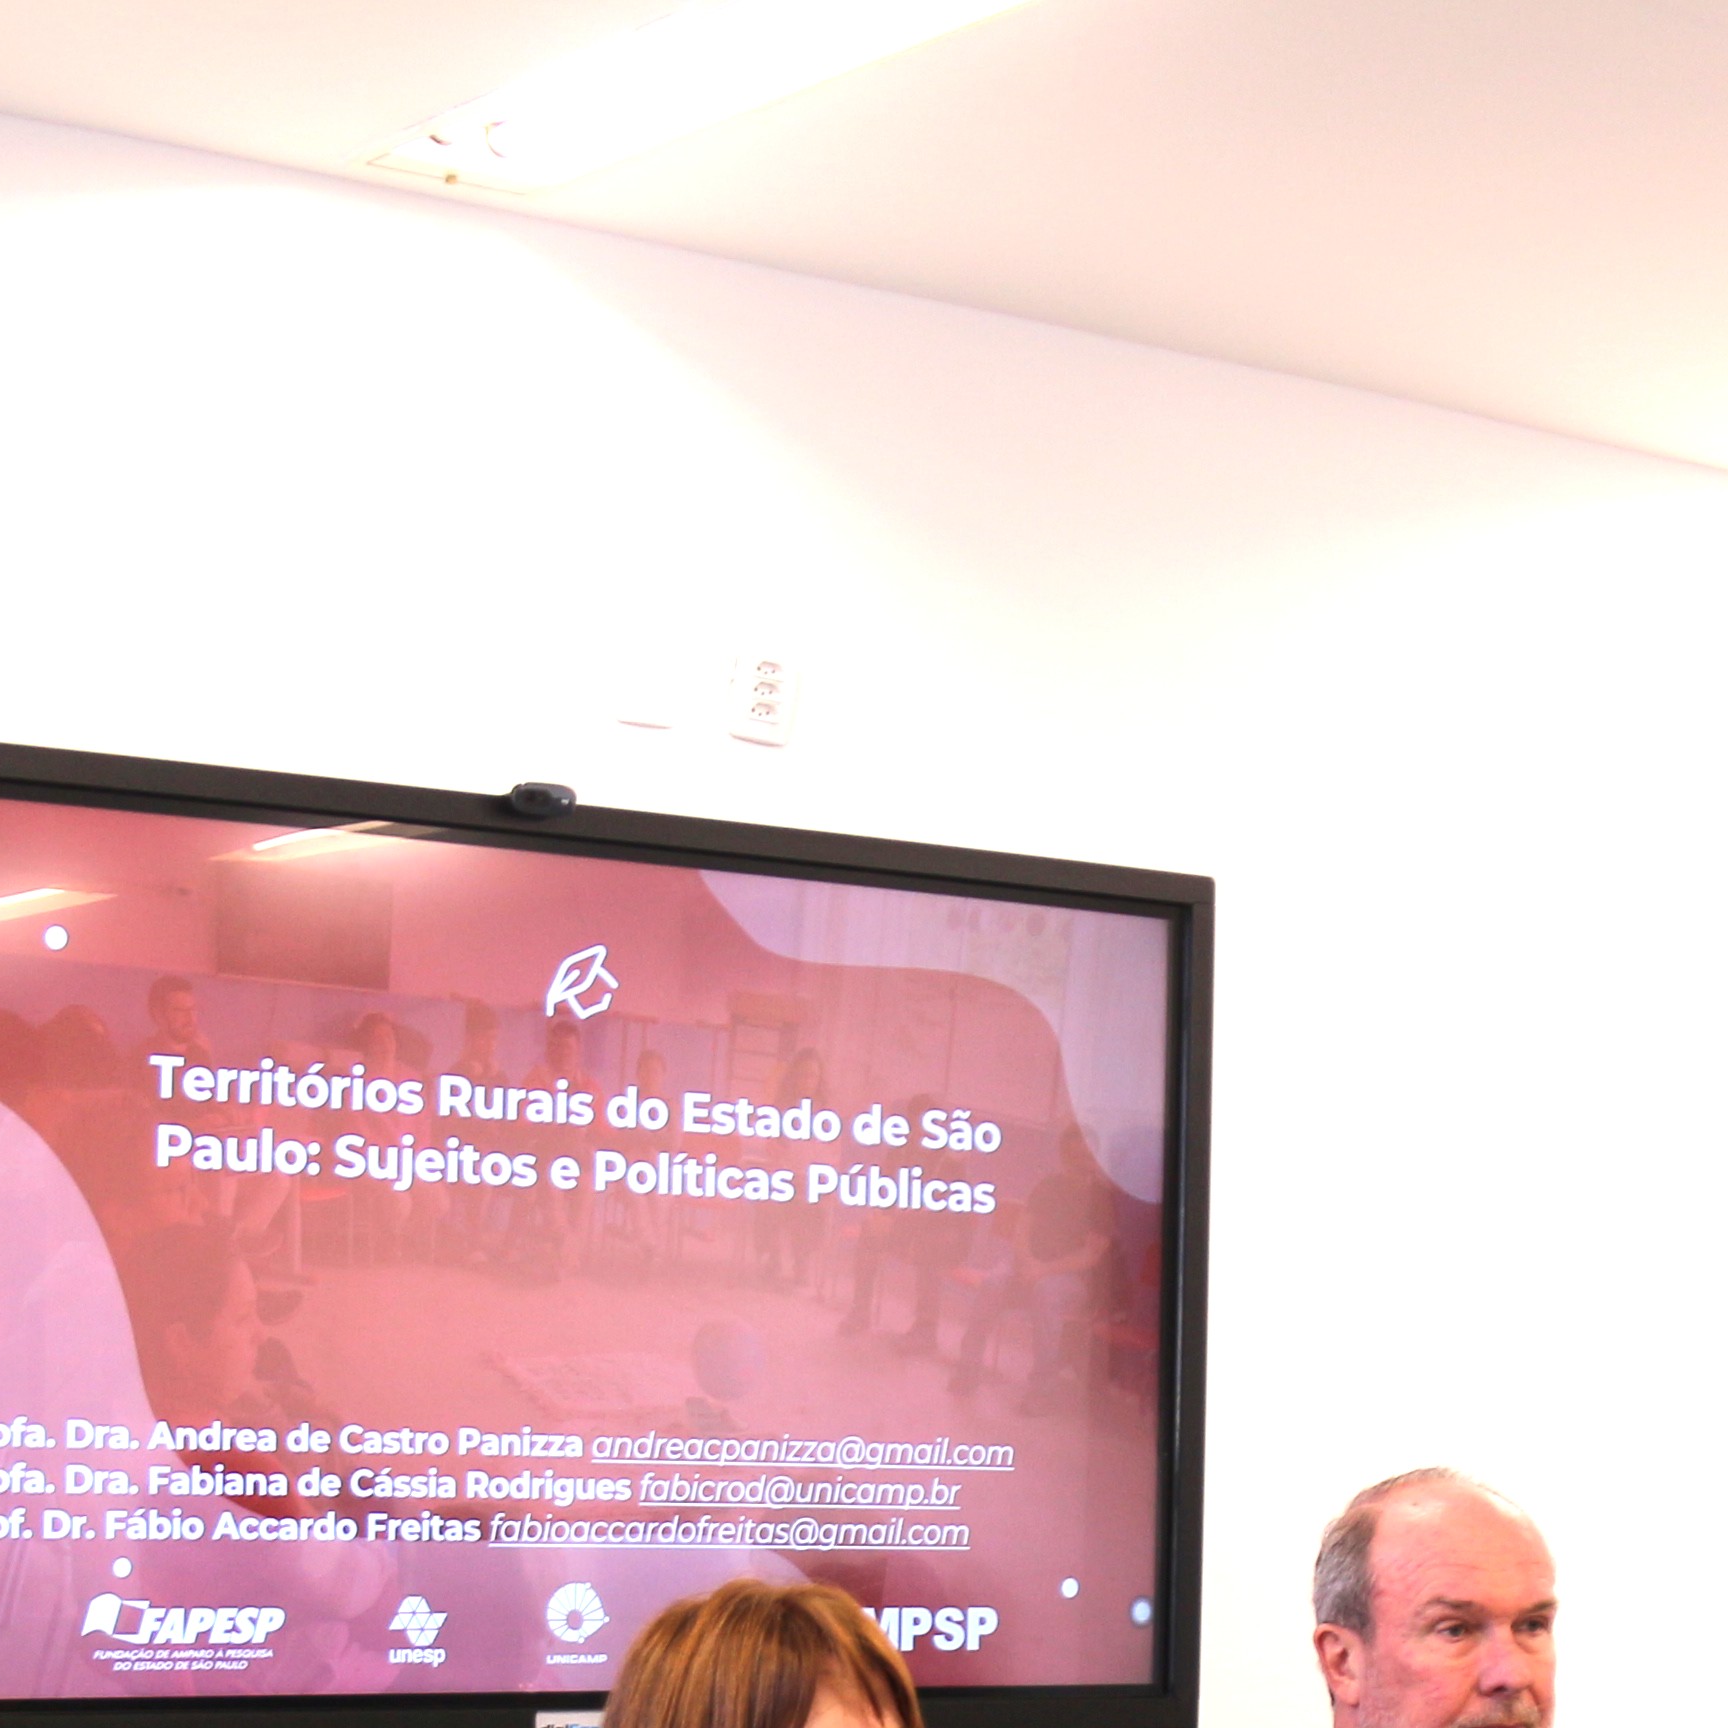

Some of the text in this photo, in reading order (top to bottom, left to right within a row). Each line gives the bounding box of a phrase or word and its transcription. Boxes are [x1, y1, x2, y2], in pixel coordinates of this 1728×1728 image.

[149, 1054, 1001, 1152] Territórios Rurais do Estado de São
[156, 1124, 996, 1214] Paulo: Sujeitos e Políticas Públicas
[66, 1418, 139, 1449] Dra.
[148, 1420, 276, 1452] Andrea
[286, 1422, 330, 1453] de
[339, 1424, 449, 1456] Castro
[458, 1427, 583, 1457] Panizza
[592, 1431, 1014, 1471] andreacpanizza@gmail.com
[65, 1464, 139, 1495] Dra.
[149, 1464, 287, 1496] Fabiana
[297, 1467, 342, 1497] de
[350, 1467, 456, 1499] Cássia
[467, 1470, 632, 1507] Rodrigues
[639, 1473, 961, 1510] fabicrod@unicamp.br
[42, 1509, 96, 1539] Dr.
[104, 1508, 204, 1541] Fábio
[212, 1512, 357, 1542] Accardo
[367, 1511, 481, 1543] Freitas
[488, 1513, 970, 1550] fabioaccardofreitas@gmail.com
[142, 1606, 286, 1645] FAPESP
[112, 1658, 249, 1671] DO ESTADO DE SÃO PAULO
[388, 1647, 446, 1667] unesp
[546, 1653, 608, 1665] UNICAMP
